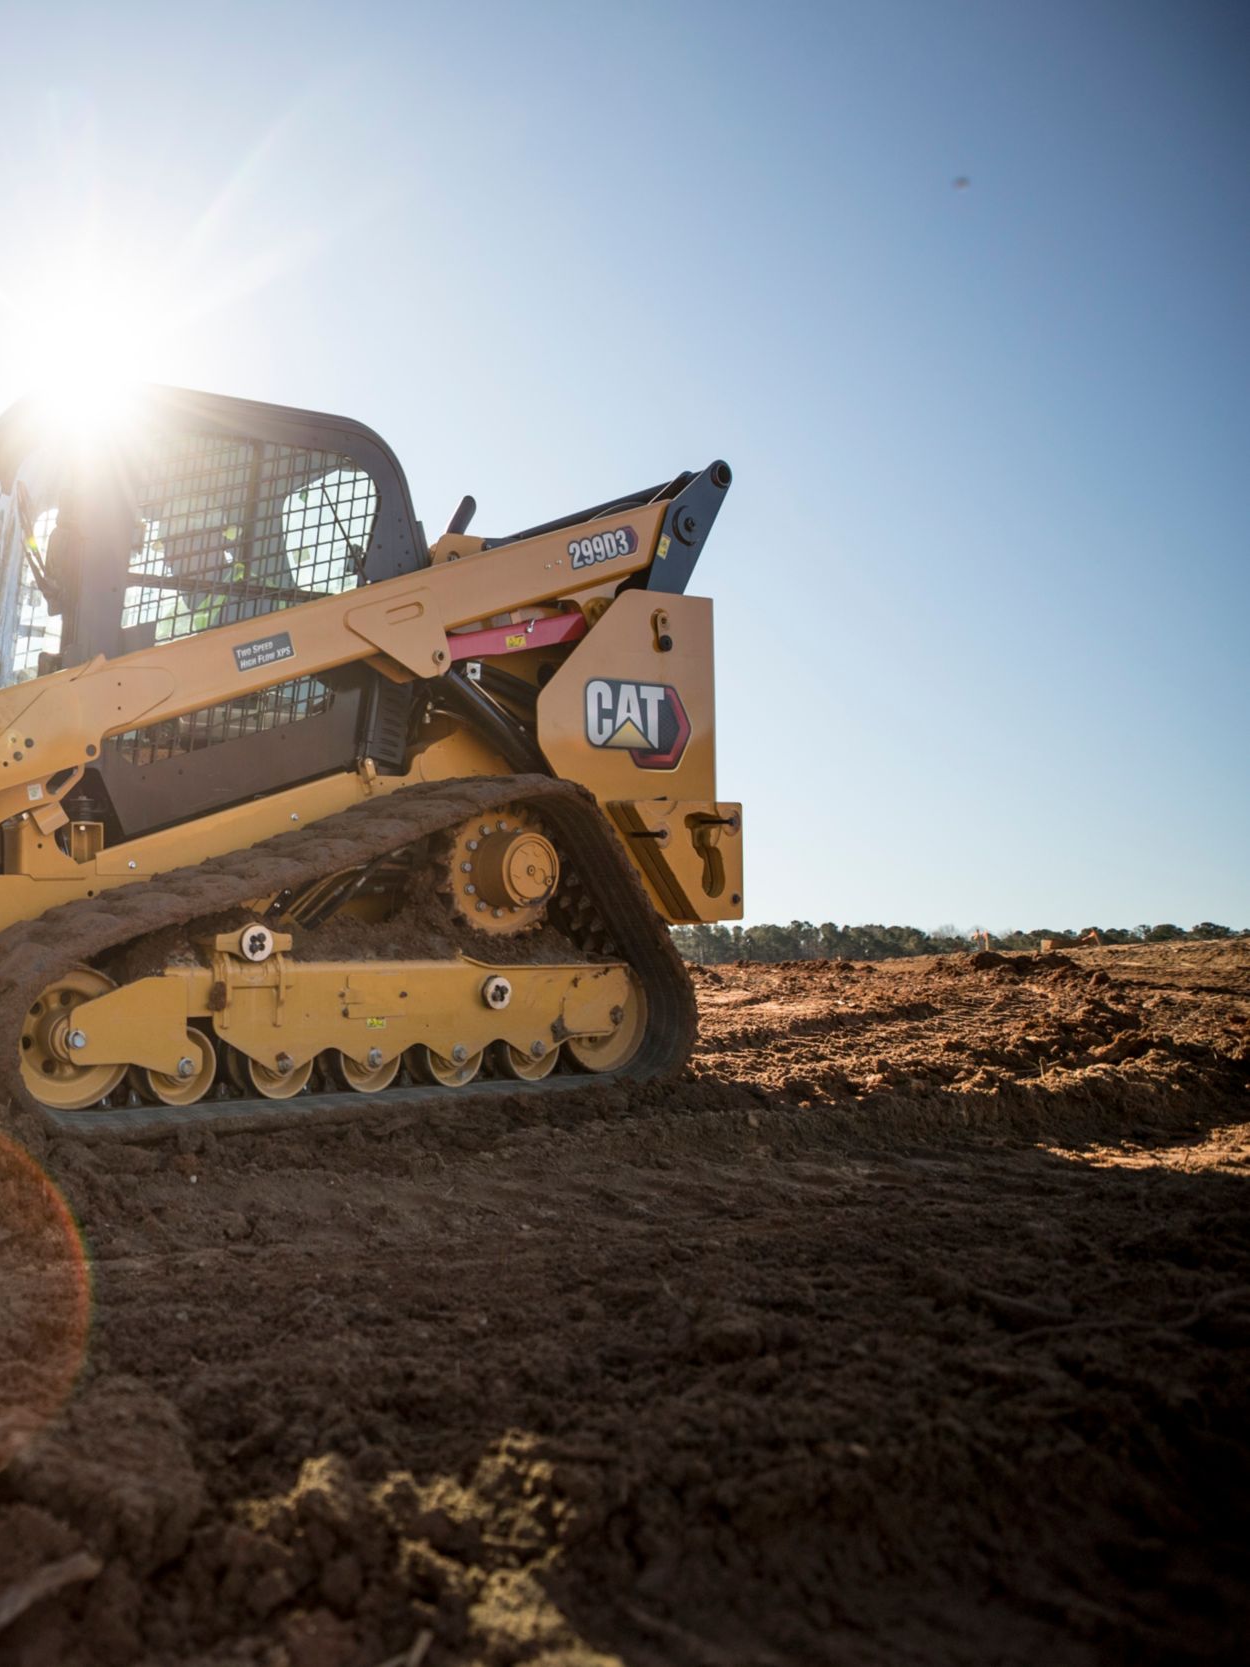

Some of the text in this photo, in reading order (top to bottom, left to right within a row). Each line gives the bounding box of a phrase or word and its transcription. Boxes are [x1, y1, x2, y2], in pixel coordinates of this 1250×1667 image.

[568, 529, 629, 569] 299D3
[236, 641, 273, 659] TWO SPEED
[276, 646, 291, 658] XPS
[586, 680, 665, 749] CAT
